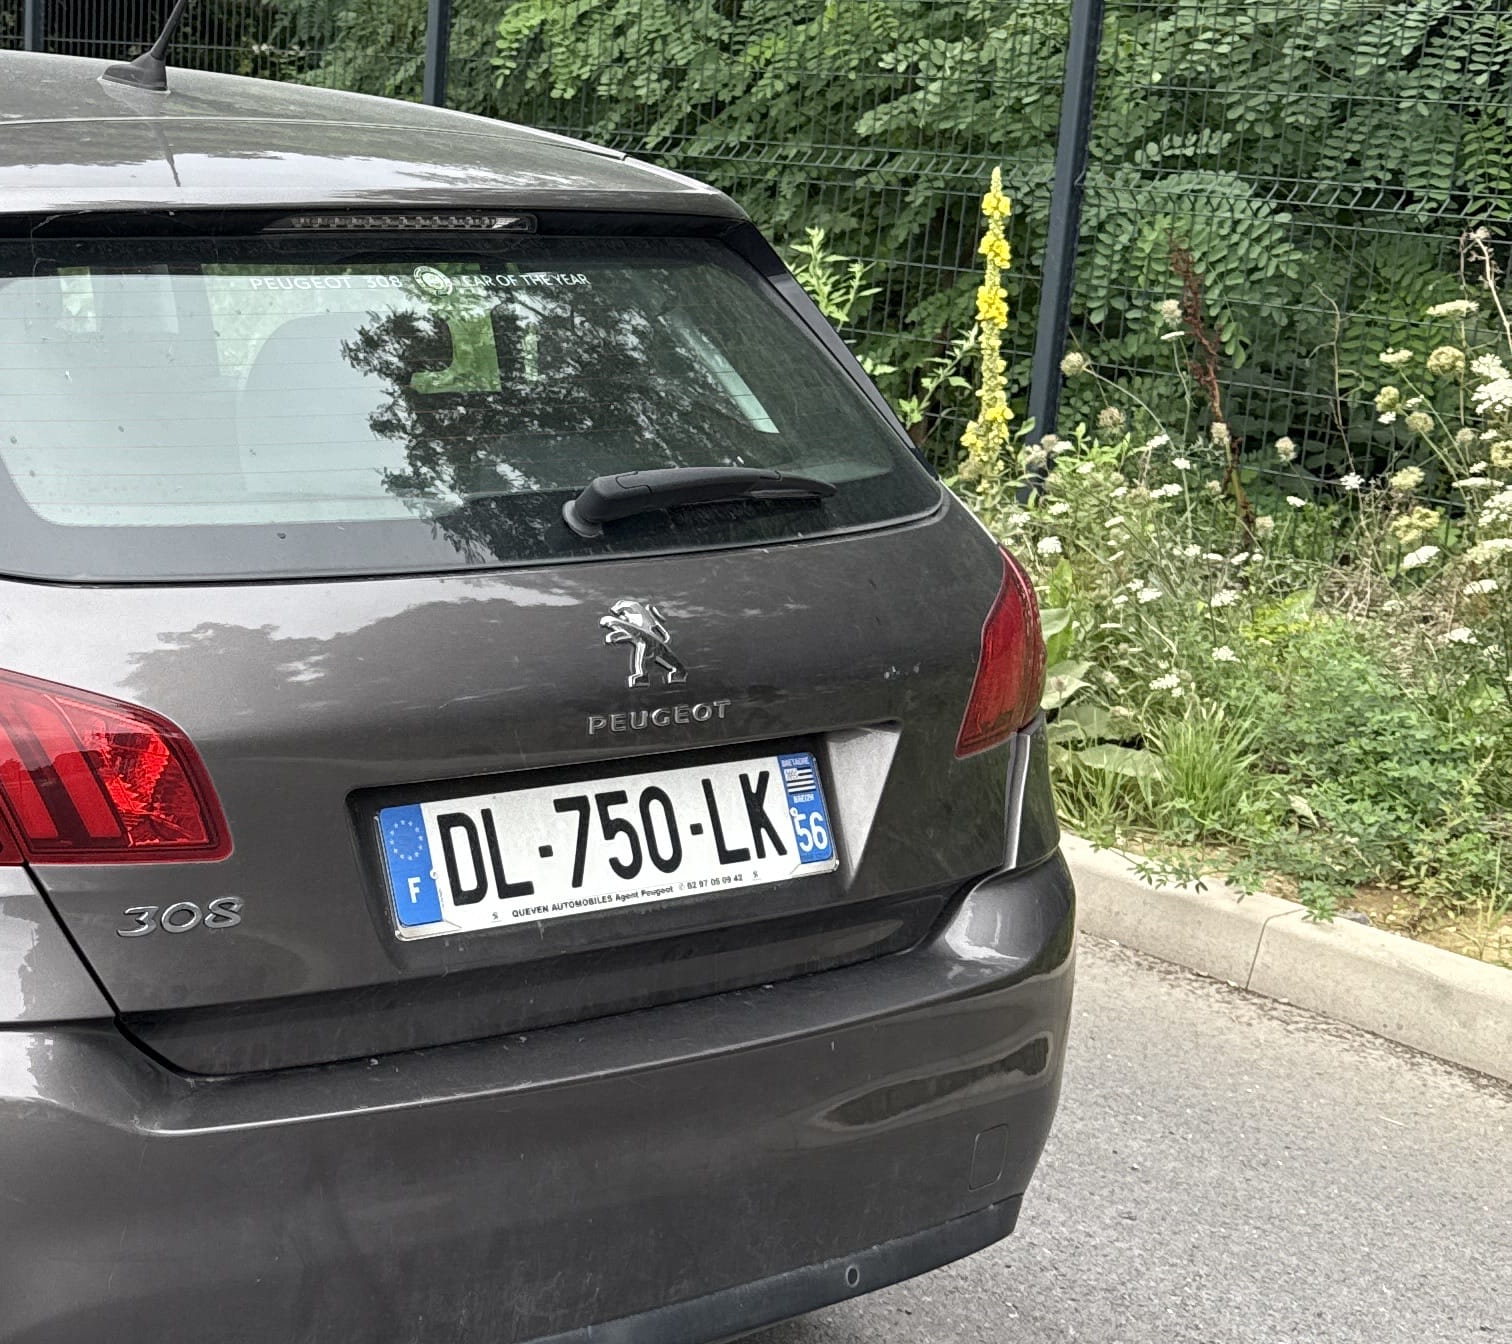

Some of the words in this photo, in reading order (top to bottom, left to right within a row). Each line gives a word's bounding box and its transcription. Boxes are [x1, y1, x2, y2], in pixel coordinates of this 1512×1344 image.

[249, 275, 352, 290] PEUGEOT
[366, 274, 403, 289] 308
[496, 274, 517, 287] OF
[519, 274, 554, 287] THE
[551, 273, 592, 286] YEAR
[588, 699, 731, 735] PEUGEOT
[794, 811, 828, 852] 56
[407, 876, 422, 904] F
[512, 904, 549, 918] QUEVEN
[551, 894, 613, 912] AUTOMOBILES
[615, 891, 639, 903] Agent
[641, 886, 674, 898] Peugeot
[117, 896, 244, 937] 308
